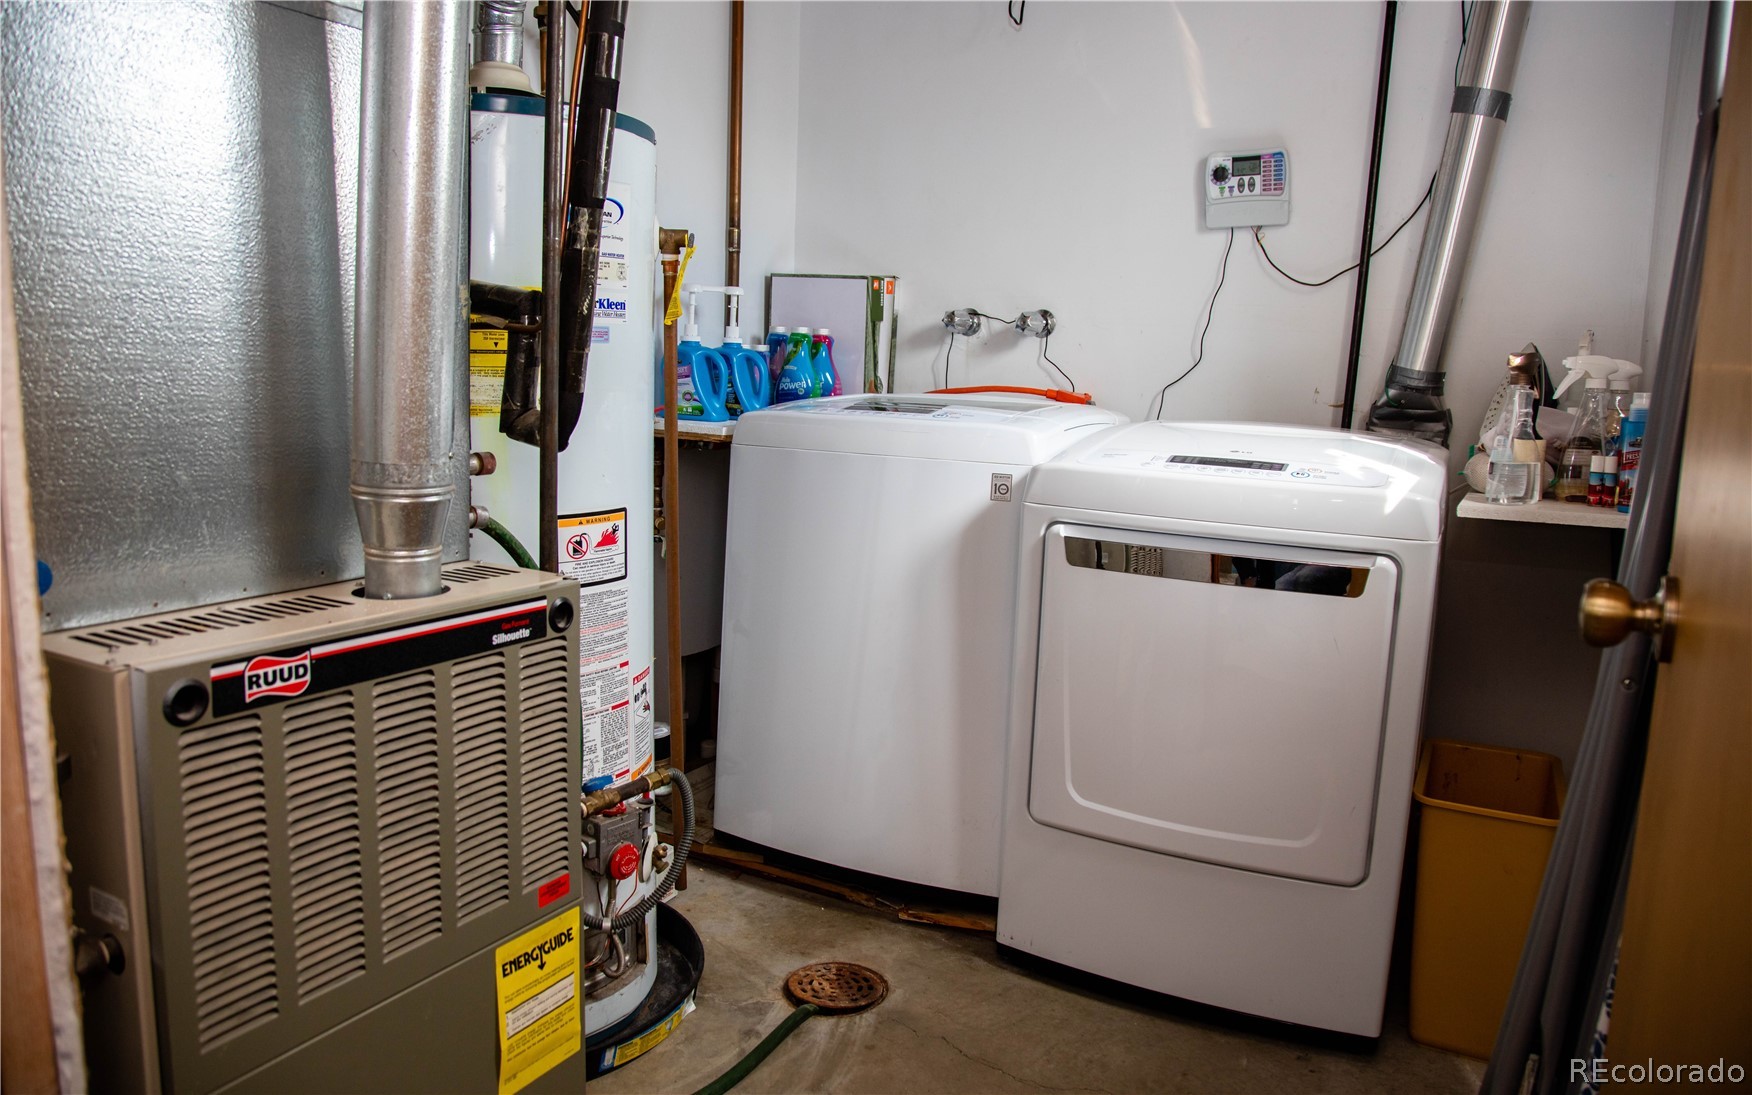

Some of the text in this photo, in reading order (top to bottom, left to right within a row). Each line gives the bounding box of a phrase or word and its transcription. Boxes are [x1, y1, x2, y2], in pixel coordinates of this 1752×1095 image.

[586, 516, 611, 524] WARNING
[492, 628, 530, 645] Silhouette
[247, 663, 308, 691] RUUD
[502, 927, 574, 978] ENERGYGUIDE
